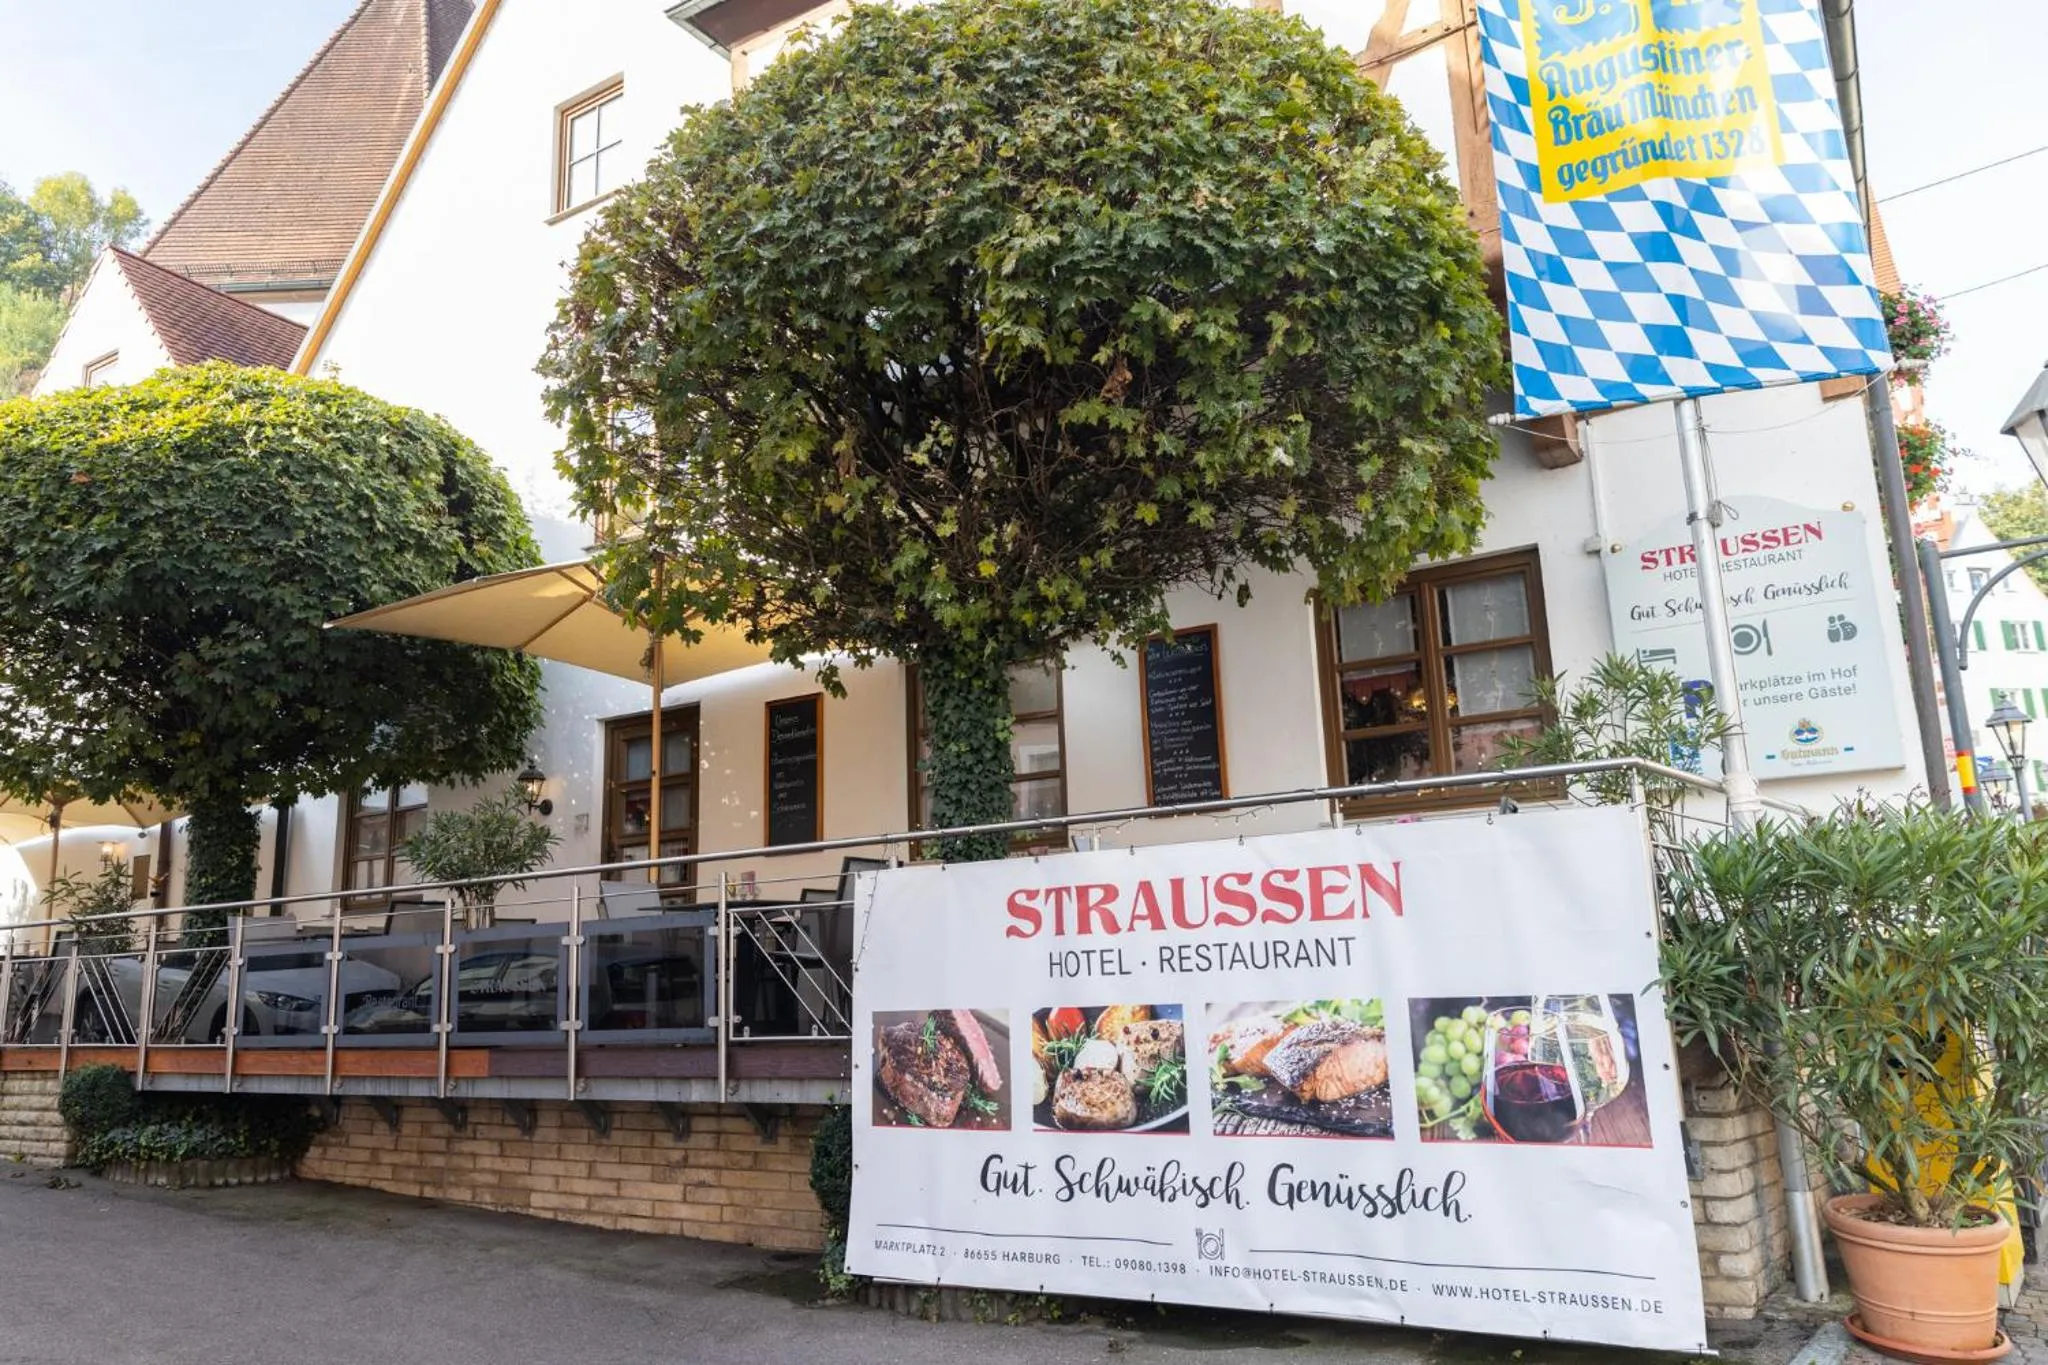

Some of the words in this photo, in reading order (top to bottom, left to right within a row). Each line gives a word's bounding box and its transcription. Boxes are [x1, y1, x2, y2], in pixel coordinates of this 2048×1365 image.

[1547, 99, 1625, 147] Bräu
[1622, 82, 1758, 126] München
[1557, 131, 1697, 192] gegründet
[1701, 126, 1766, 161] 1328
[1640, 521, 1824, 571] STRUSSEN
[1663, 568, 1698, 583] HOTE
[1739, 673, 1804, 692] rkplätze
[1807, 670, 1826, 683] im
[1830, 664, 1858, 680] Hof
[1752, 690, 1804, 707] unsere
[1808, 682, 1858, 700] Gäste!
[1006, 860, 1404, 939] STRAUSSEN
[1048, 947, 1133, 978] HOTEL
[1158, 936, 1357, 974] RESTAURANT
[979, 1153, 1043, 1199] Gut.
[1054, 1154, 1252, 1211] Schwäbisch.
[1266, 1162, 1473, 1223] Genüsslich.
[963, 1248, 998, 1261] 86655
[1002, 1252, 1061, 1265] HARBURG
[1081, 1255, 1111, 1269] TEL.:
[1114, 1258, 1187, 1274] 09080.1398
[1209, 1265, 1408, 1293] INFO@HOTEL-STRAUSSEN.DE
[1432, 1283, 1665, 1315] WWW.HOTEL-STRAUSSEN.DE
